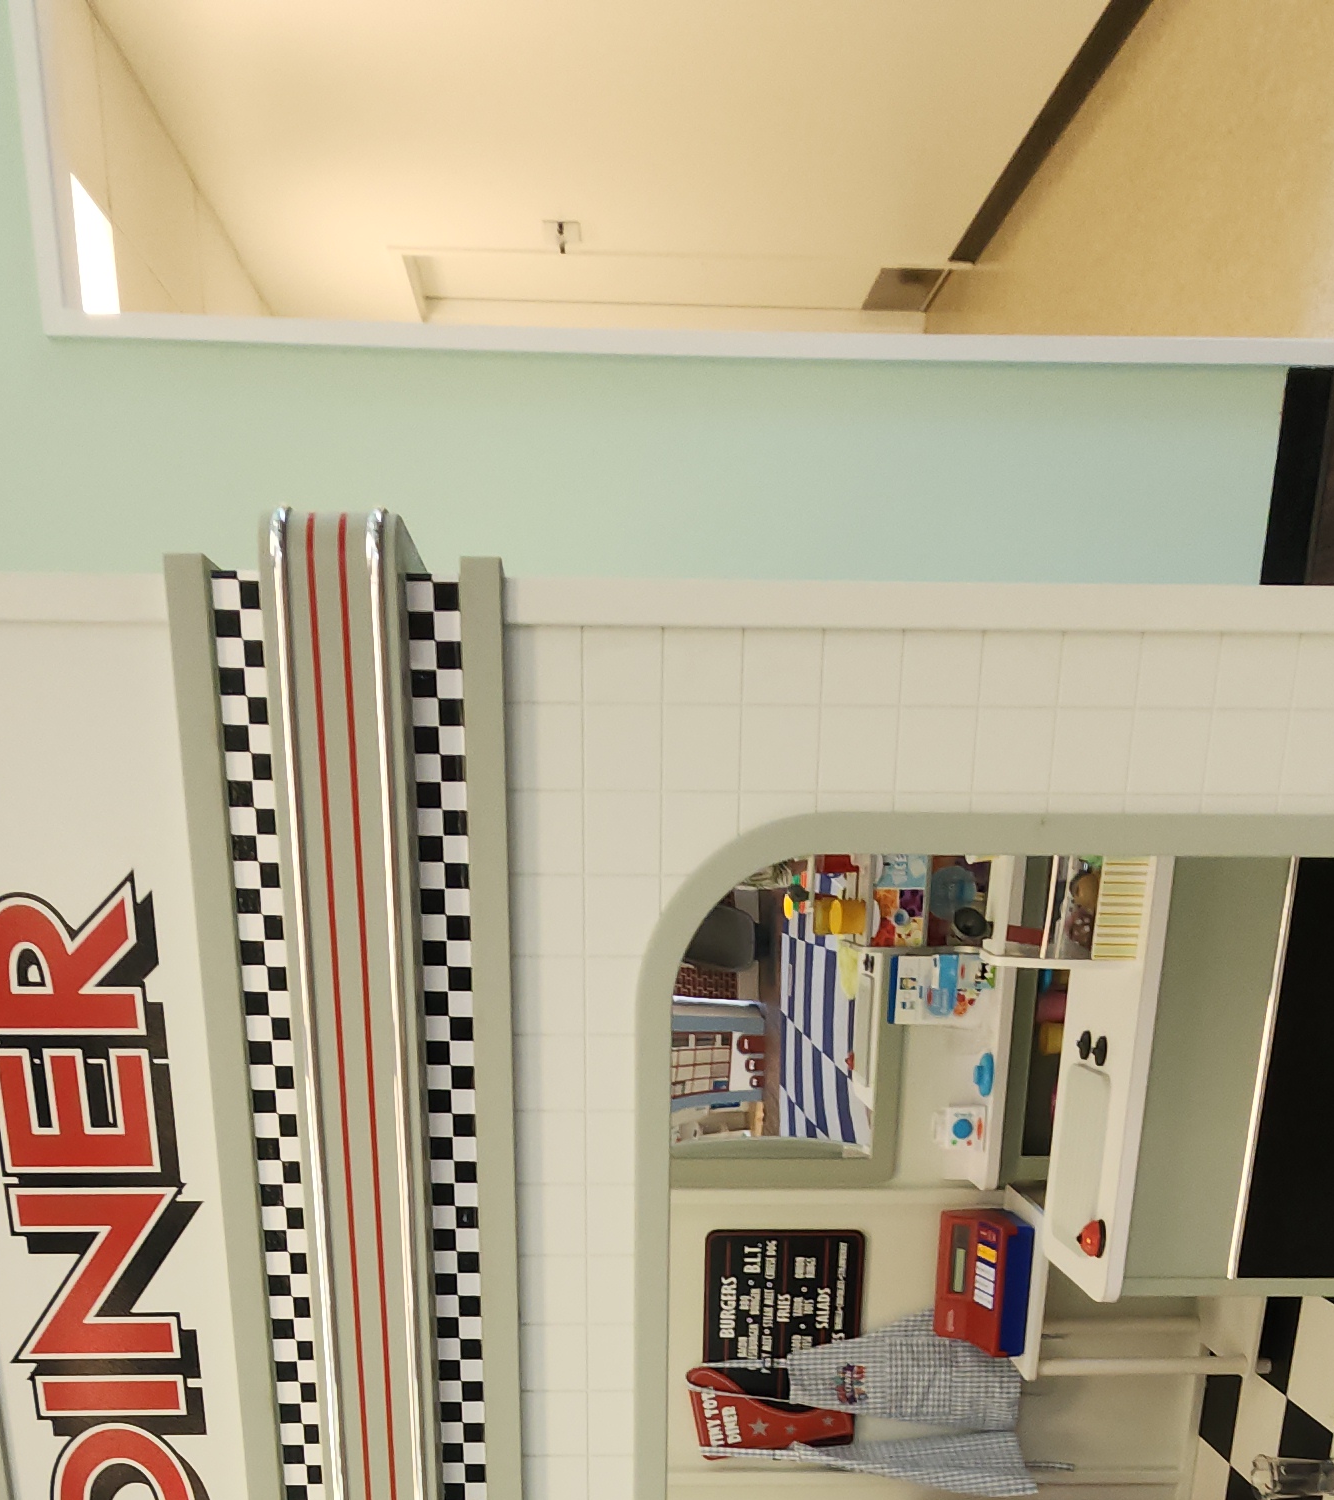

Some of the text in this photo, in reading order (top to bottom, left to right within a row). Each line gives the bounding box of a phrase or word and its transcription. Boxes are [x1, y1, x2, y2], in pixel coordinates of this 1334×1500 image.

[743, 1242, 762, 1274] B.L.T.
[765, 1240, 778, 1256] DOG
[719, 1276, 737, 1338] BURGERS
[776, 1293, 791, 1323] FRIES
[815, 1287, 831, 1329] SALADS
[705, 1419, 725, 1446] TINY
[721, 1406, 743, 1444] DINER
